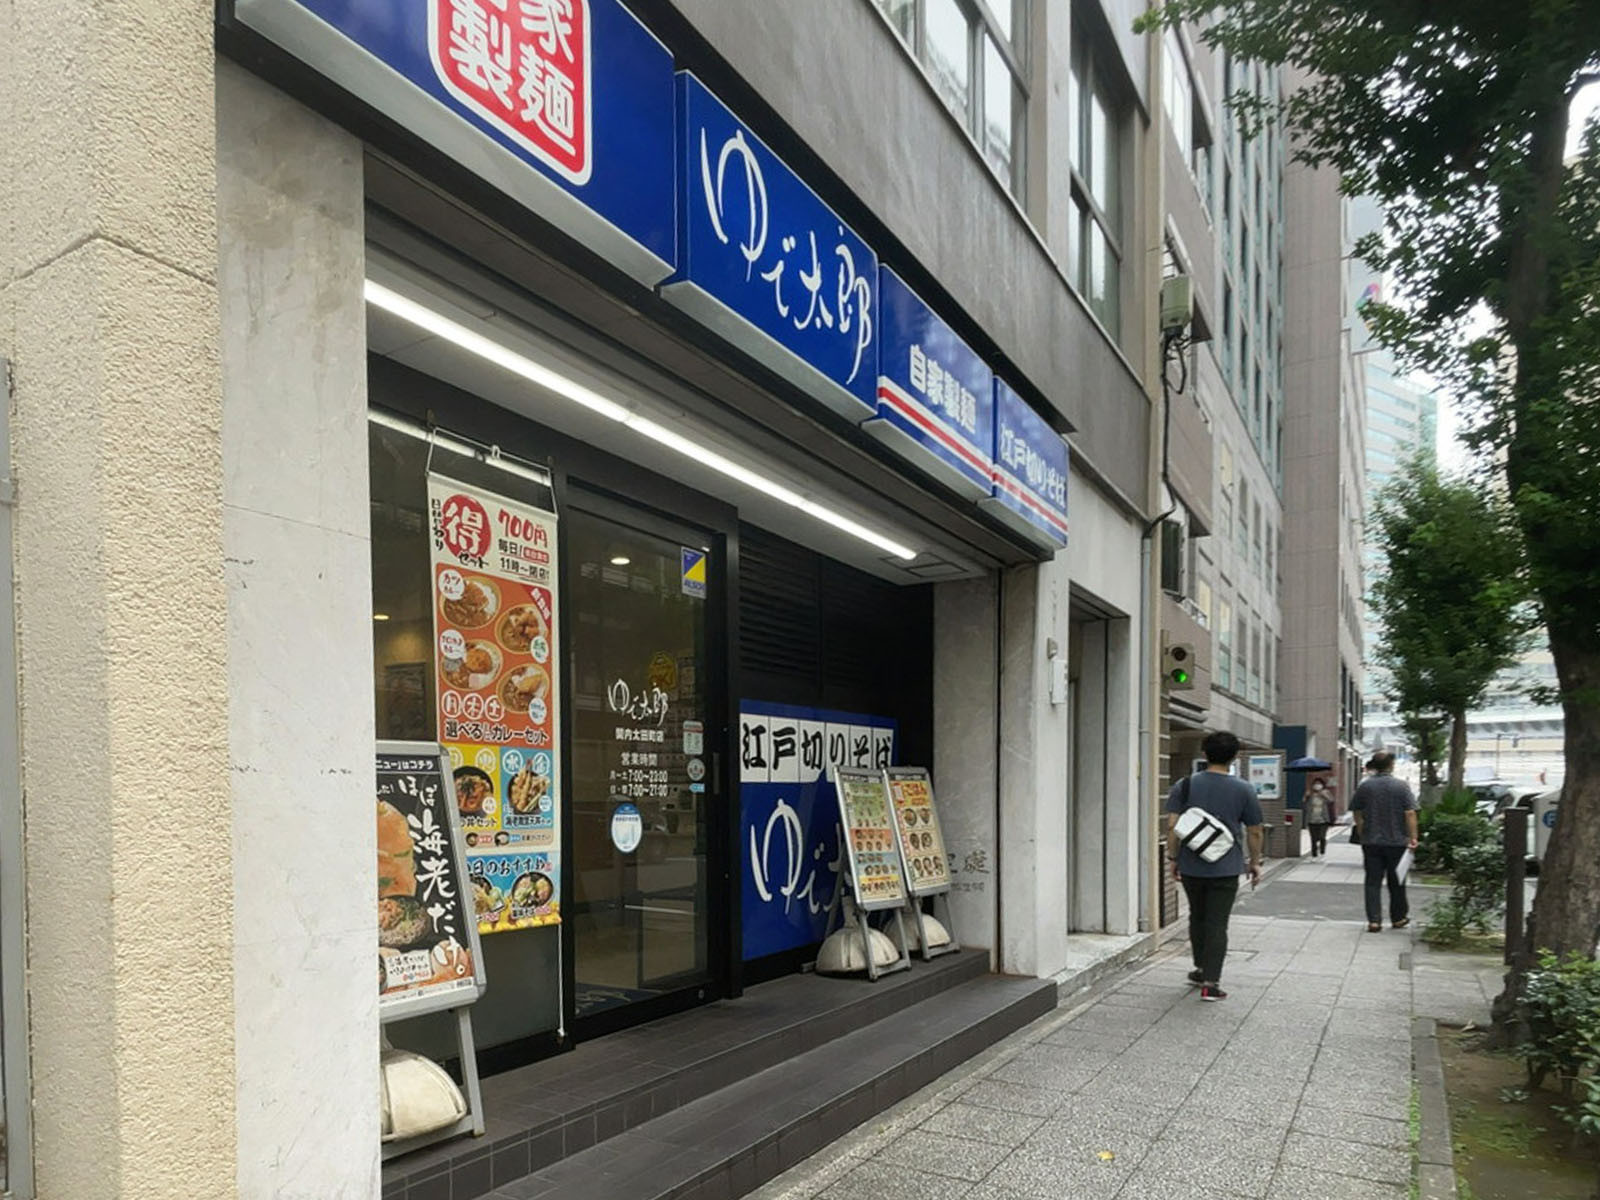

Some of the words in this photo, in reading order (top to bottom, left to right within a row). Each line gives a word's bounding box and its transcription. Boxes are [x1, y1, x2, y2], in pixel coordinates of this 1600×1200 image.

[701, 127, 871, 385] ゆで太郎
[445, 502, 484, 554] 得
[498, 508, 548, 548] 700円
[607, 678, 669, 727] ゆで太郎
[743, 722, 891, 770] 江戸切りそば
